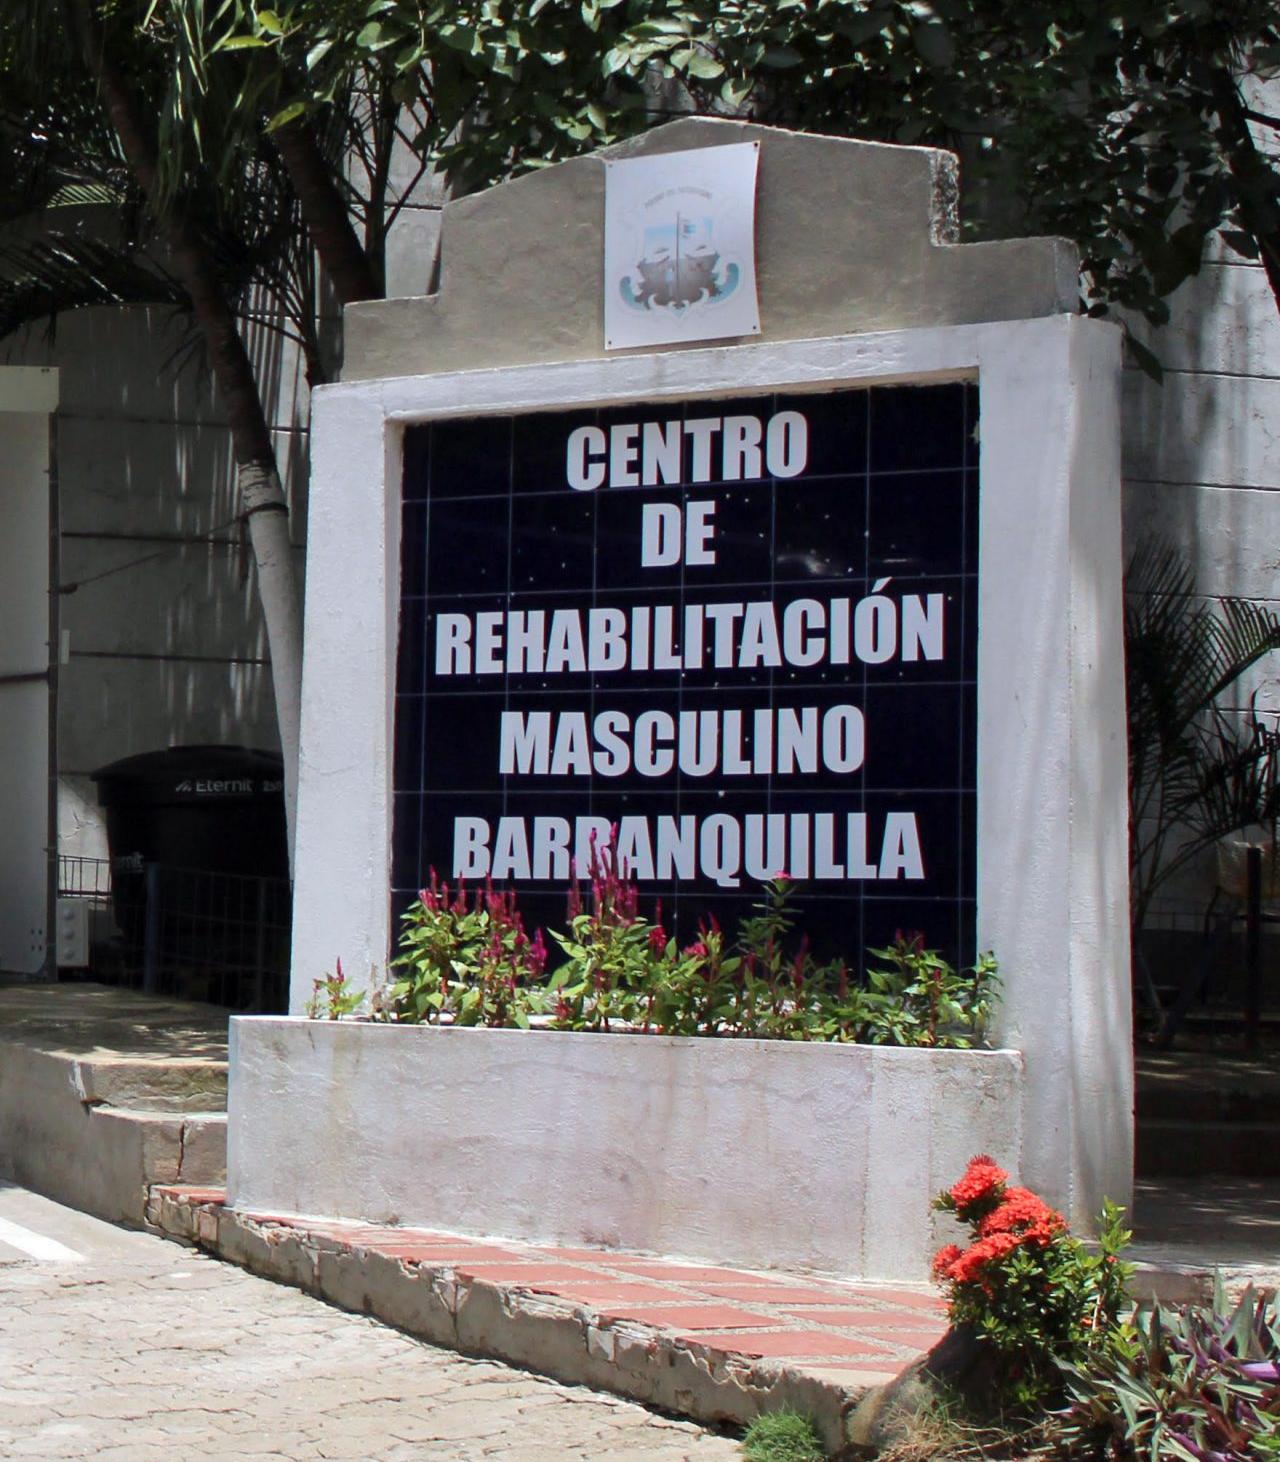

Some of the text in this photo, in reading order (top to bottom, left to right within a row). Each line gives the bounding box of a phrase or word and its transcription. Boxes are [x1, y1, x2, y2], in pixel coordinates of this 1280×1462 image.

[566, 411, 808, 491] CENTRO
[641, 501, 717, 568] DE
[436, 577, 945, 676] REHABILITACIÓN
[500, 705, 865, 777] MASCULINO
[195, 779, 253, 793] Eternit
[453, 812, 926, 888] BARRANQUILLA
